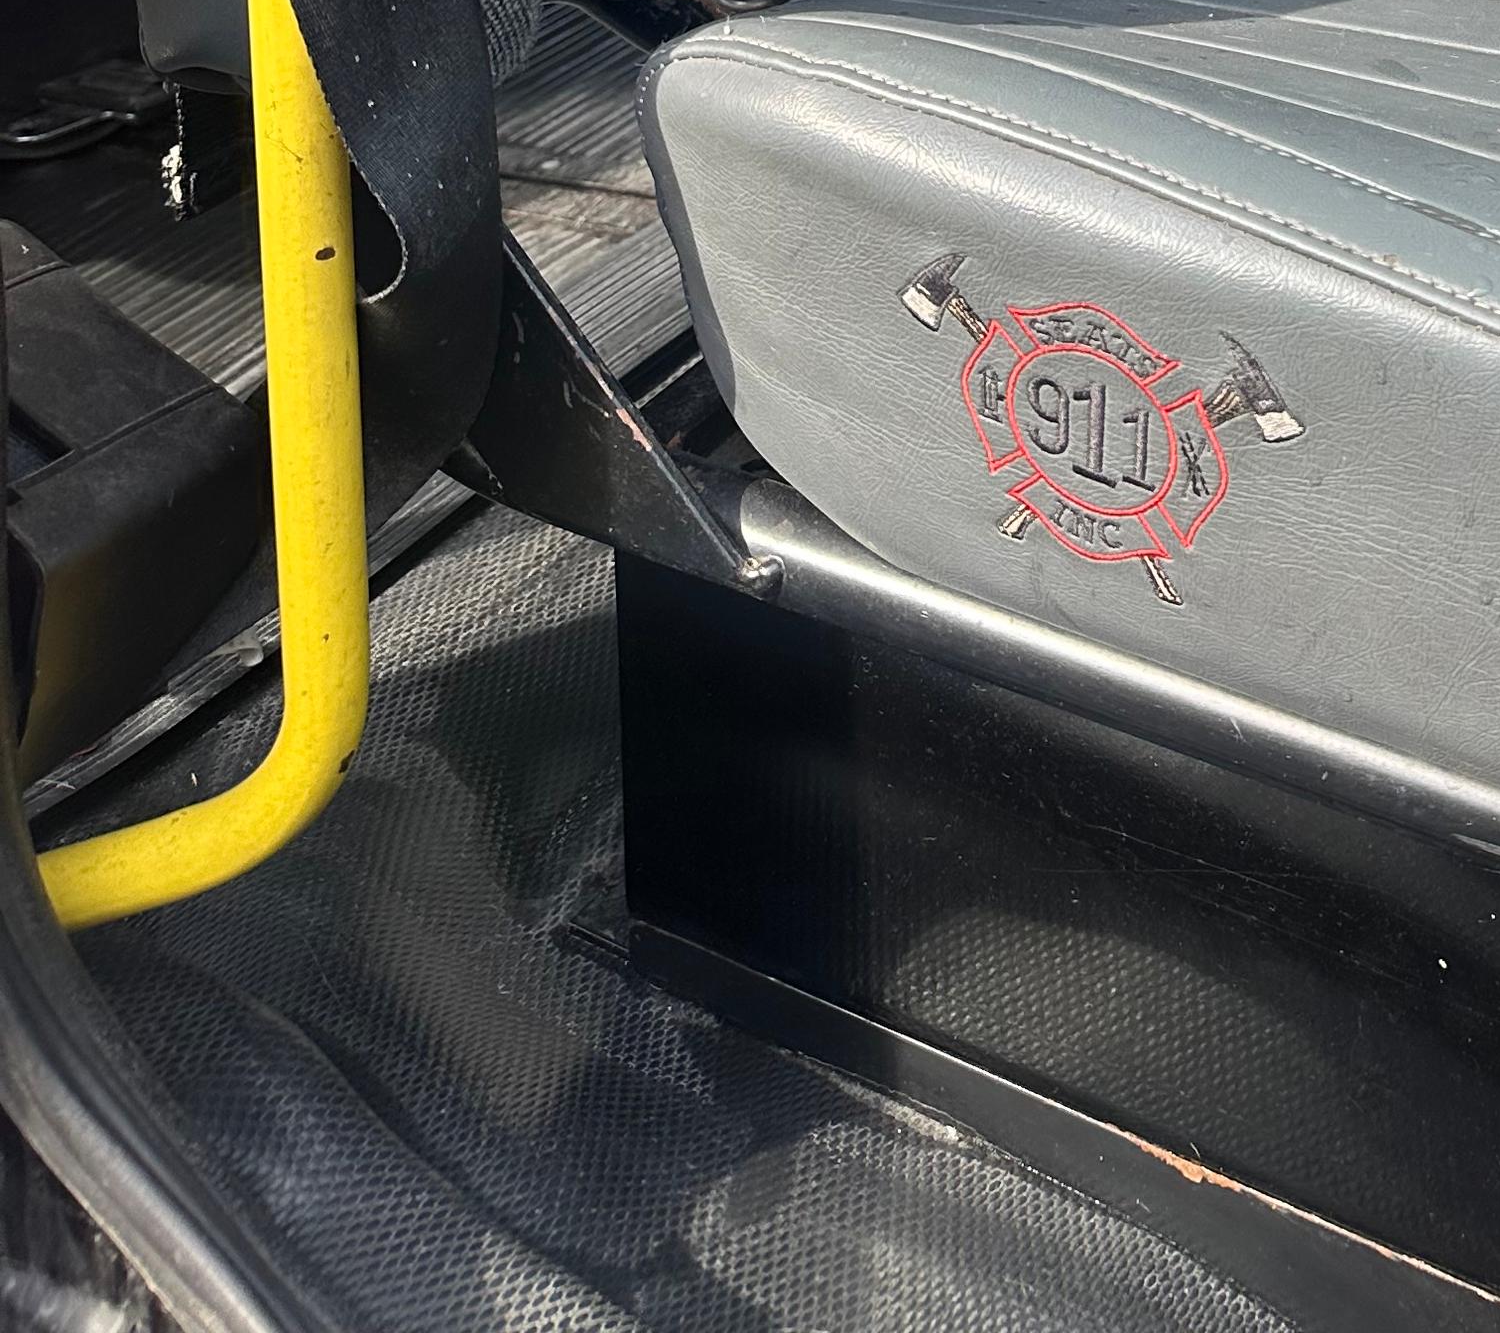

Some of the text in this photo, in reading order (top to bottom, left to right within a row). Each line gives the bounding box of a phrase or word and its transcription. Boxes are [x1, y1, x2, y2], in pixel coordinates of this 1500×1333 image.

[1029, 318, 1159, 378] SEATS
[1028, 378, 1155, 491] 911
[1050, 500, 1123, 549] INC
